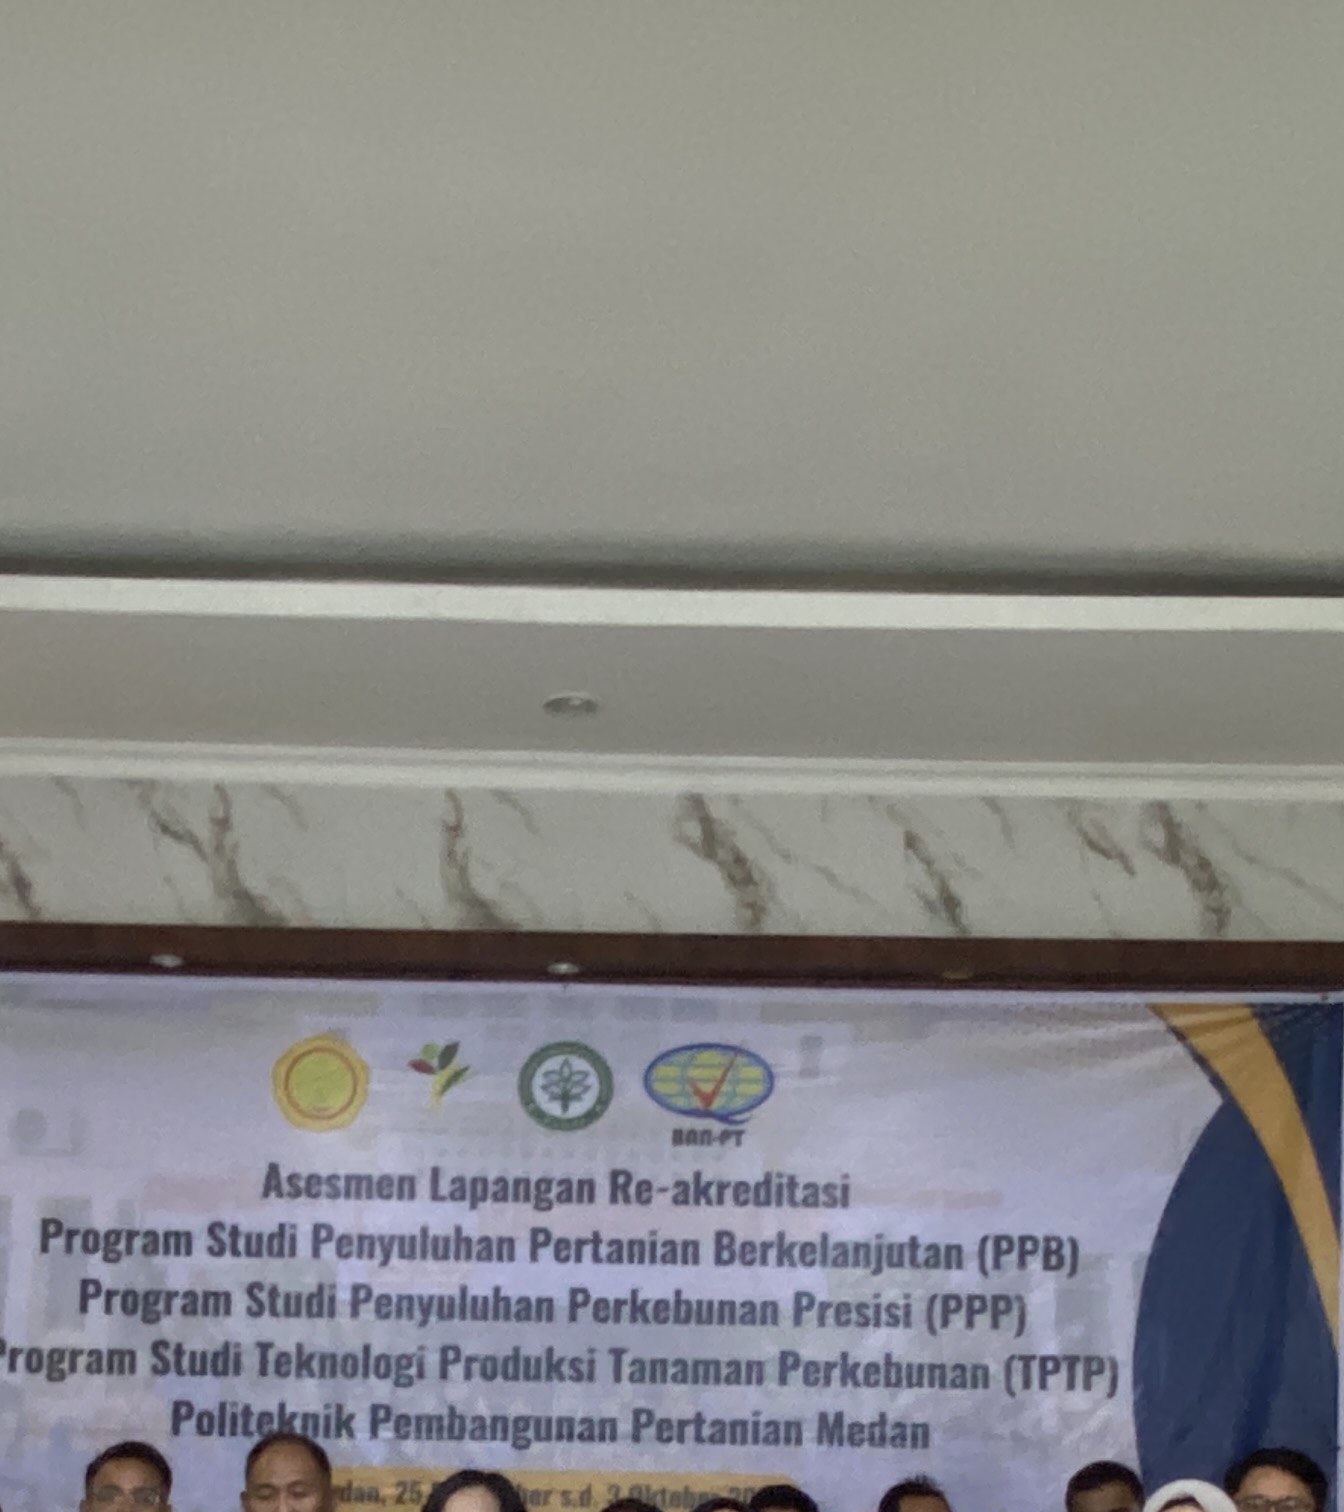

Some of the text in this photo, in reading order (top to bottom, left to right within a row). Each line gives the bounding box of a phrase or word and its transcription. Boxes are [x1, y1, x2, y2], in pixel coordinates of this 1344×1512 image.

[262, 1161, 851, 1212] Asesmen Lapangan Re-akreditasi
[39, 1216, 1080, 1279] Program Studi Penyuluhan Pertanian Berkelanjutan (PPB)
[78, 1277, 1027, 1338] Program Studi Penyuluhan Perkebunan Presisi (PPP)
[150, 1339, 243, 1378] Studi
[255, 1341, 426, 1388] Teknologi
[438, 1344, 596, 1384] Produksi
[607, 1347, 766, 1387] Tanaman
[777, 1350, 990, 1390] Perkebunan
[1003, 1353, 1119, 1399] (TPTP)
[170, 1399, 931, 1451] Politeknik Pembangunan Pertanian Medan
